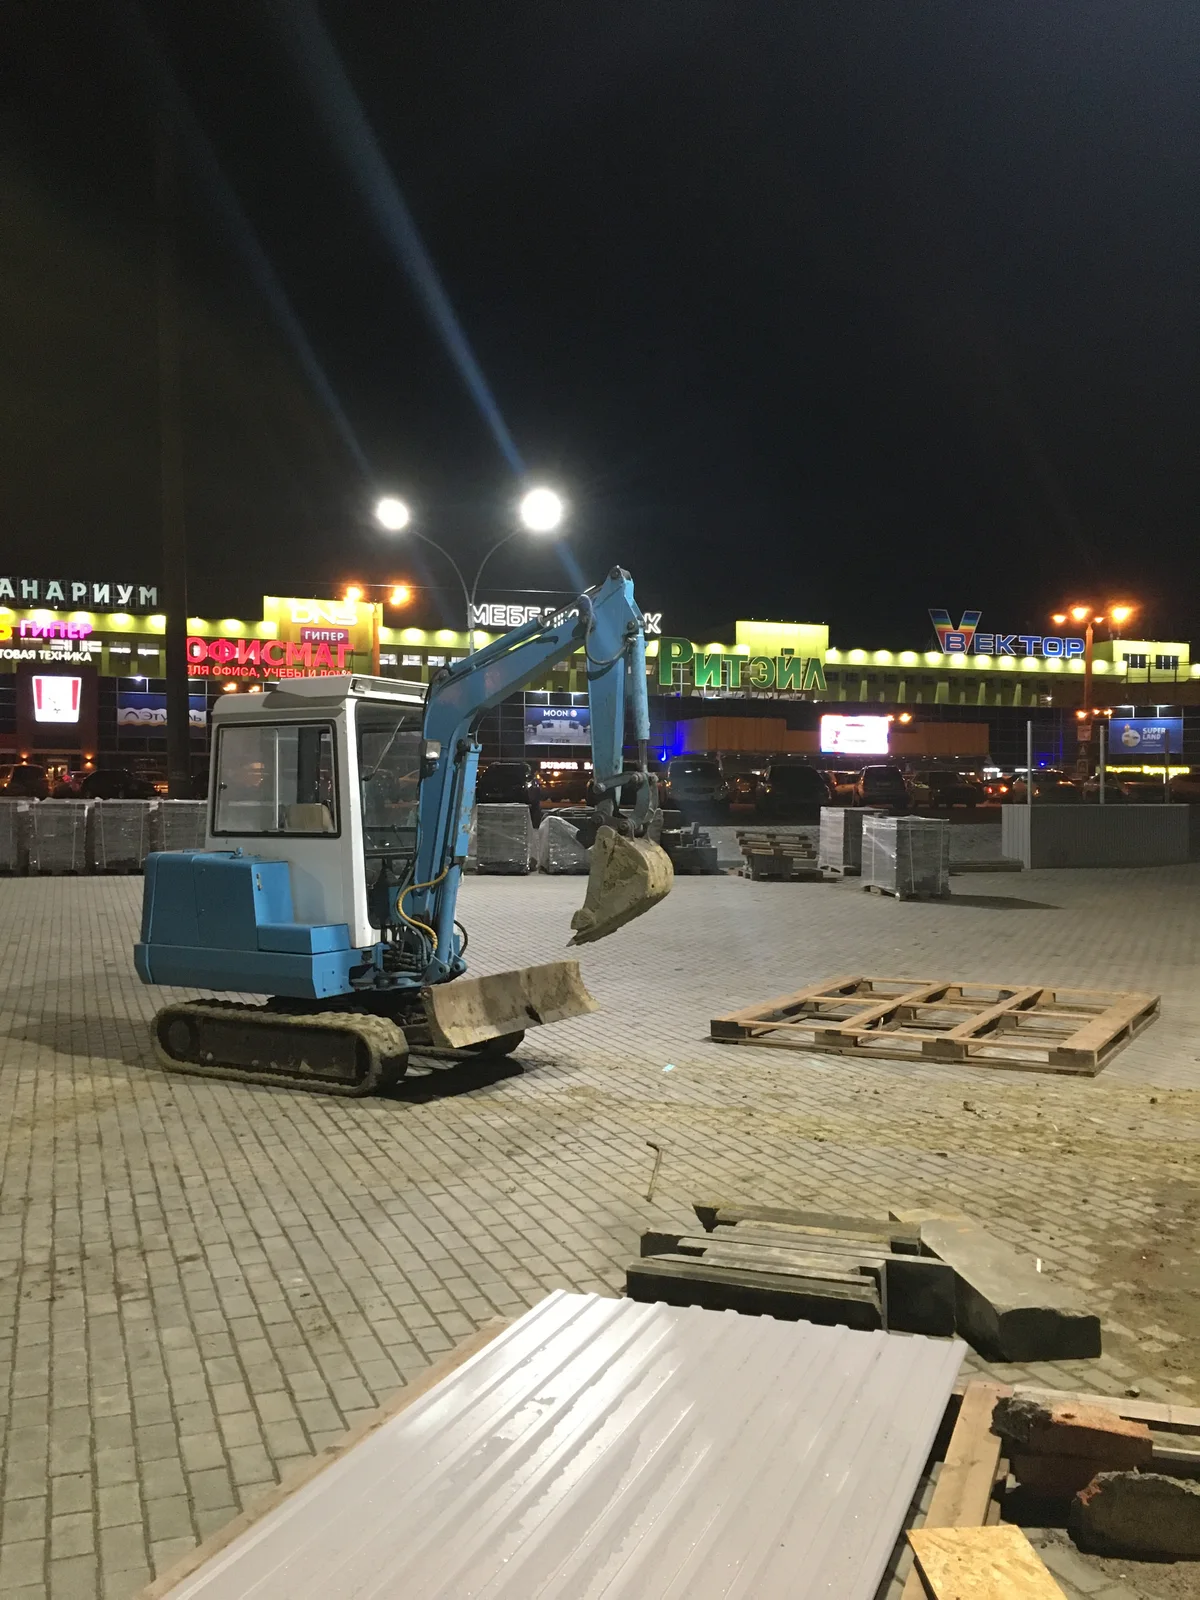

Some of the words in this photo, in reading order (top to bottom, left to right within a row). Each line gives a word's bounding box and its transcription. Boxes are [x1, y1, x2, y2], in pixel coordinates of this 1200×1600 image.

[0, 578, 158, 606] АНАРИУМ
[292, 605, 358, 626] DNS
[20, 619, 93, 640] ГИПЕР
[304, 630, 344, 641] ГИПЕР
[186, 636, 355, 668] ОФИСМАГ
[944, 632, 1086, 658] ВЕКТОР
[38, 649, 93, 662] ТЕХНИКА
[212, 665, 260, 679] ОФИСА,
[263, 667, 304, 679] УЧЕБЫ
[307, 669, 317, 679] И
[543, 709, 569, 717] MOON
[1142, 733, 1162, 741] LAND
